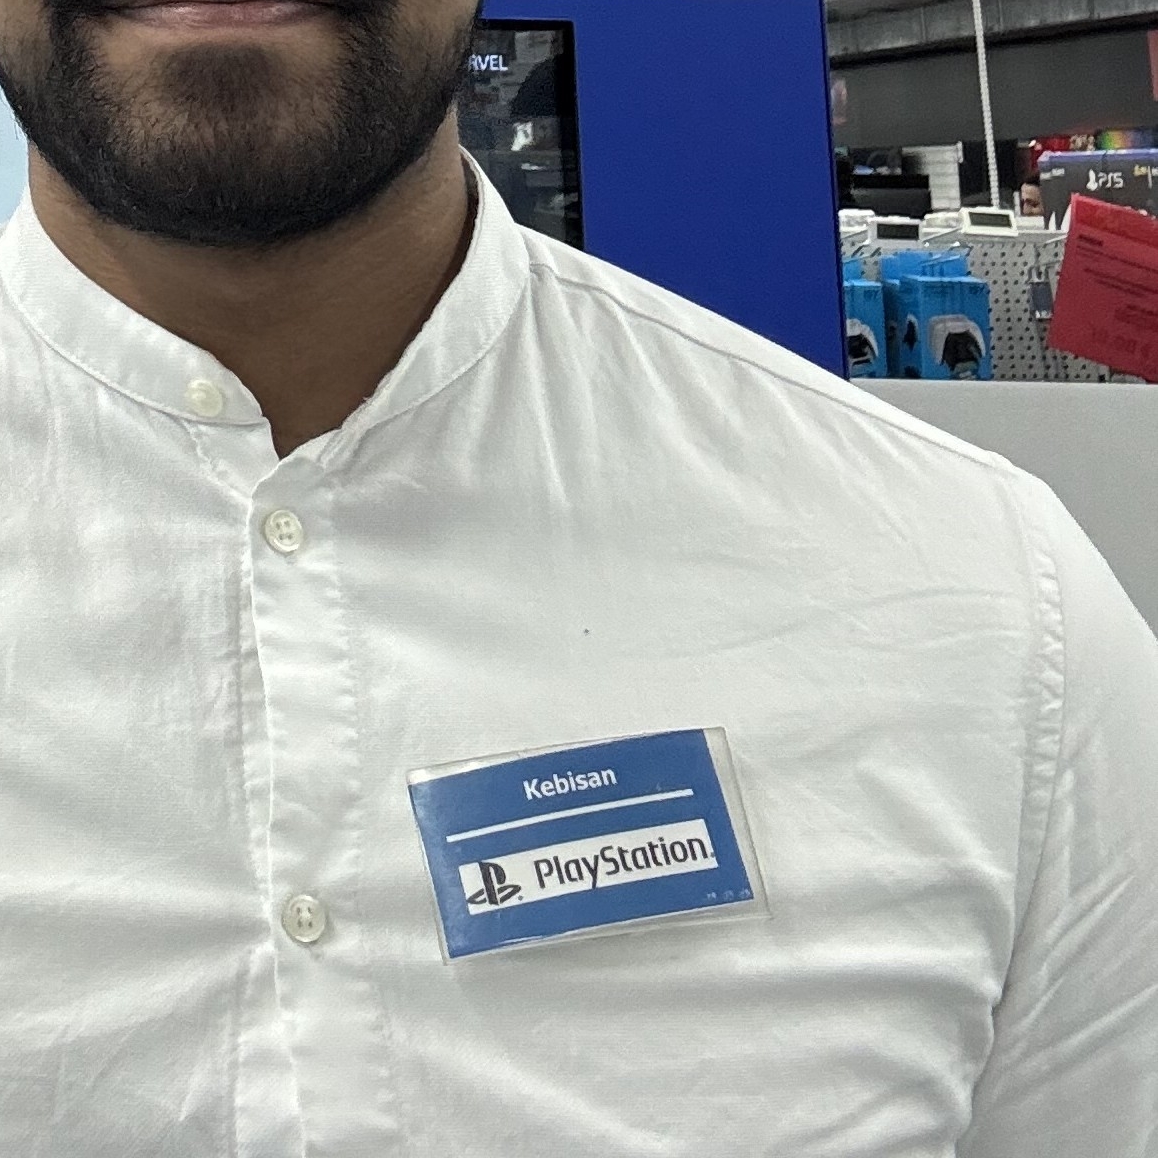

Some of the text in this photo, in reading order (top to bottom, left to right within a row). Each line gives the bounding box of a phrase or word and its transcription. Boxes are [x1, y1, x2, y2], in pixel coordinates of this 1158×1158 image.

[1098, 172, 1124, 188] PS5
[523, 766, 618, 800] Kebisan
[534, 836, 708, 889] PlayStation
